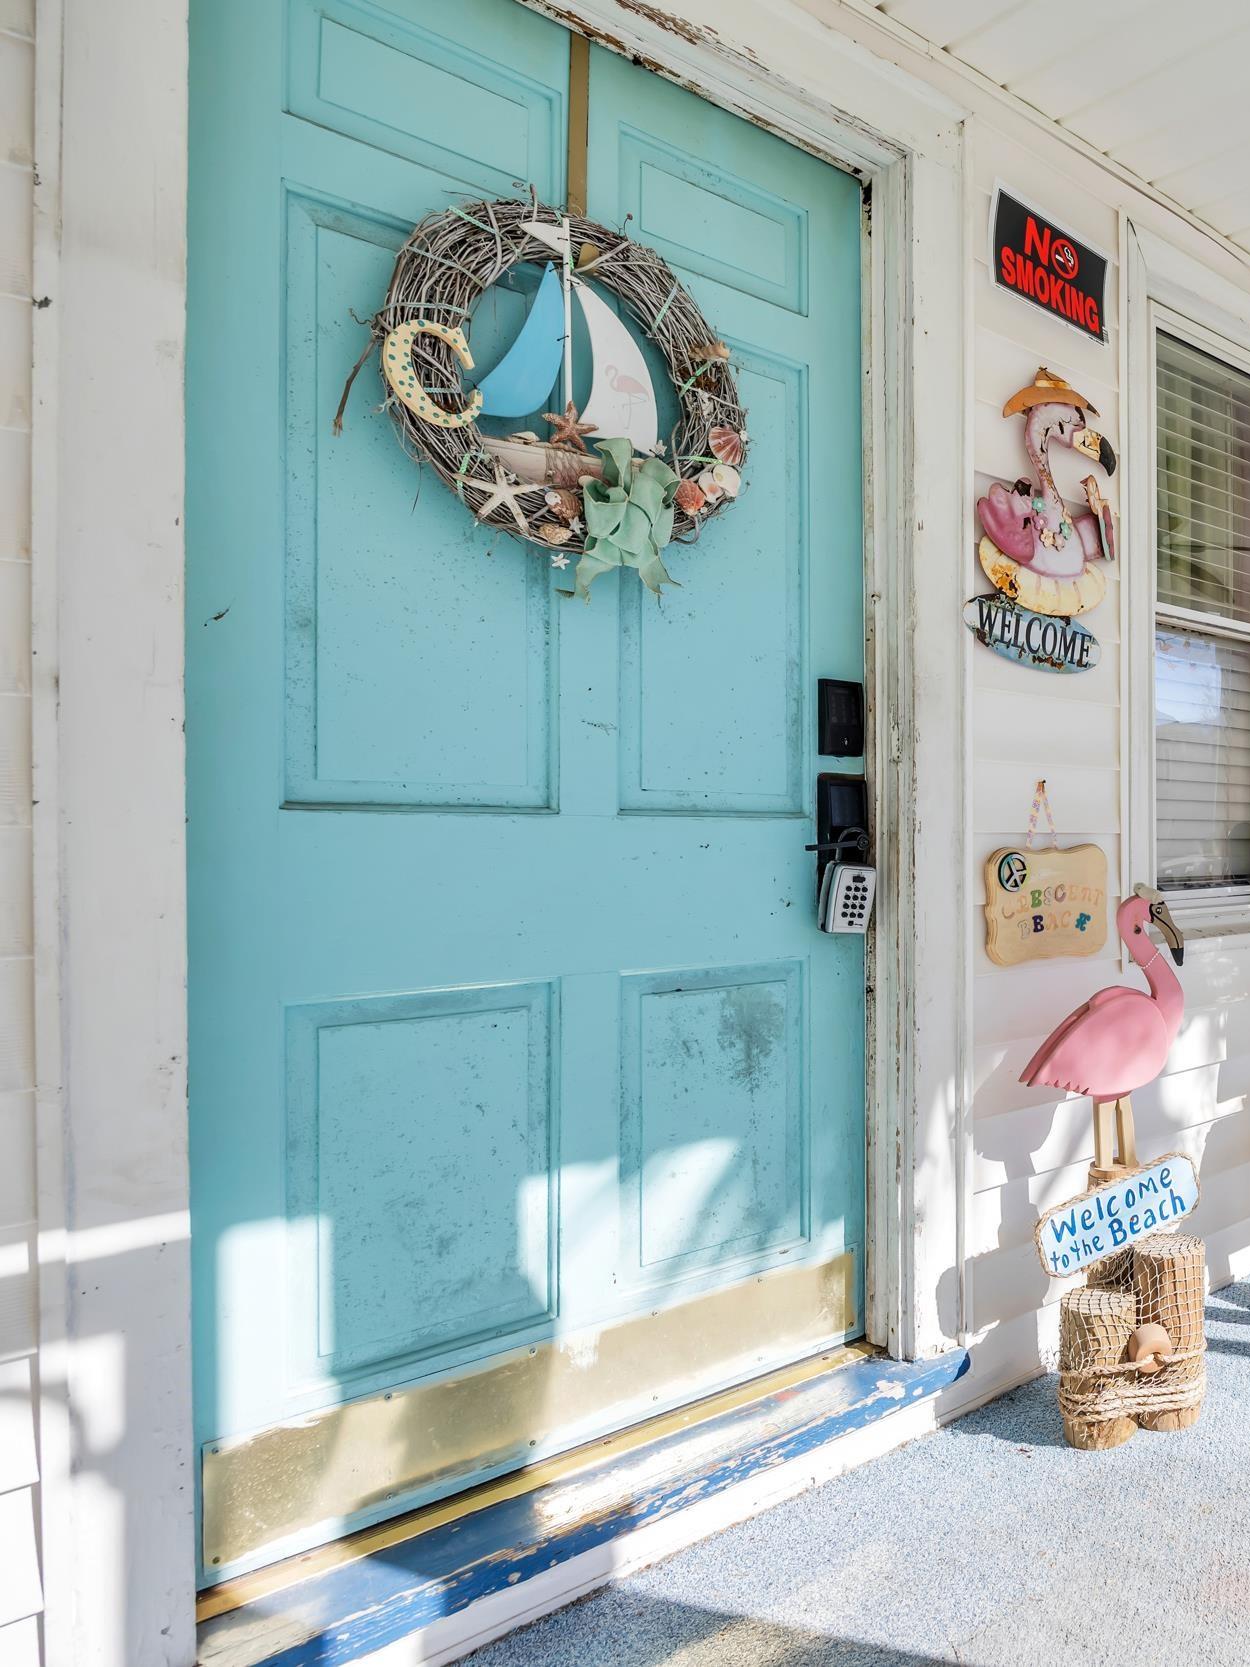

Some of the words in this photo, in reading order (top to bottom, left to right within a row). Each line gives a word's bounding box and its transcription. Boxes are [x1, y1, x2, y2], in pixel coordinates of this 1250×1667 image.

[1024, 216, 1079, 280] NO
[1001, 246, 1100, 334] SMOKING
[977, 598, 1092, 668] WELCOME
[1050, 1251, 1070, 1272] to
[1070, 1235, 1104, 1261] the
[1107, 1188, 1186, 1247] Beach
